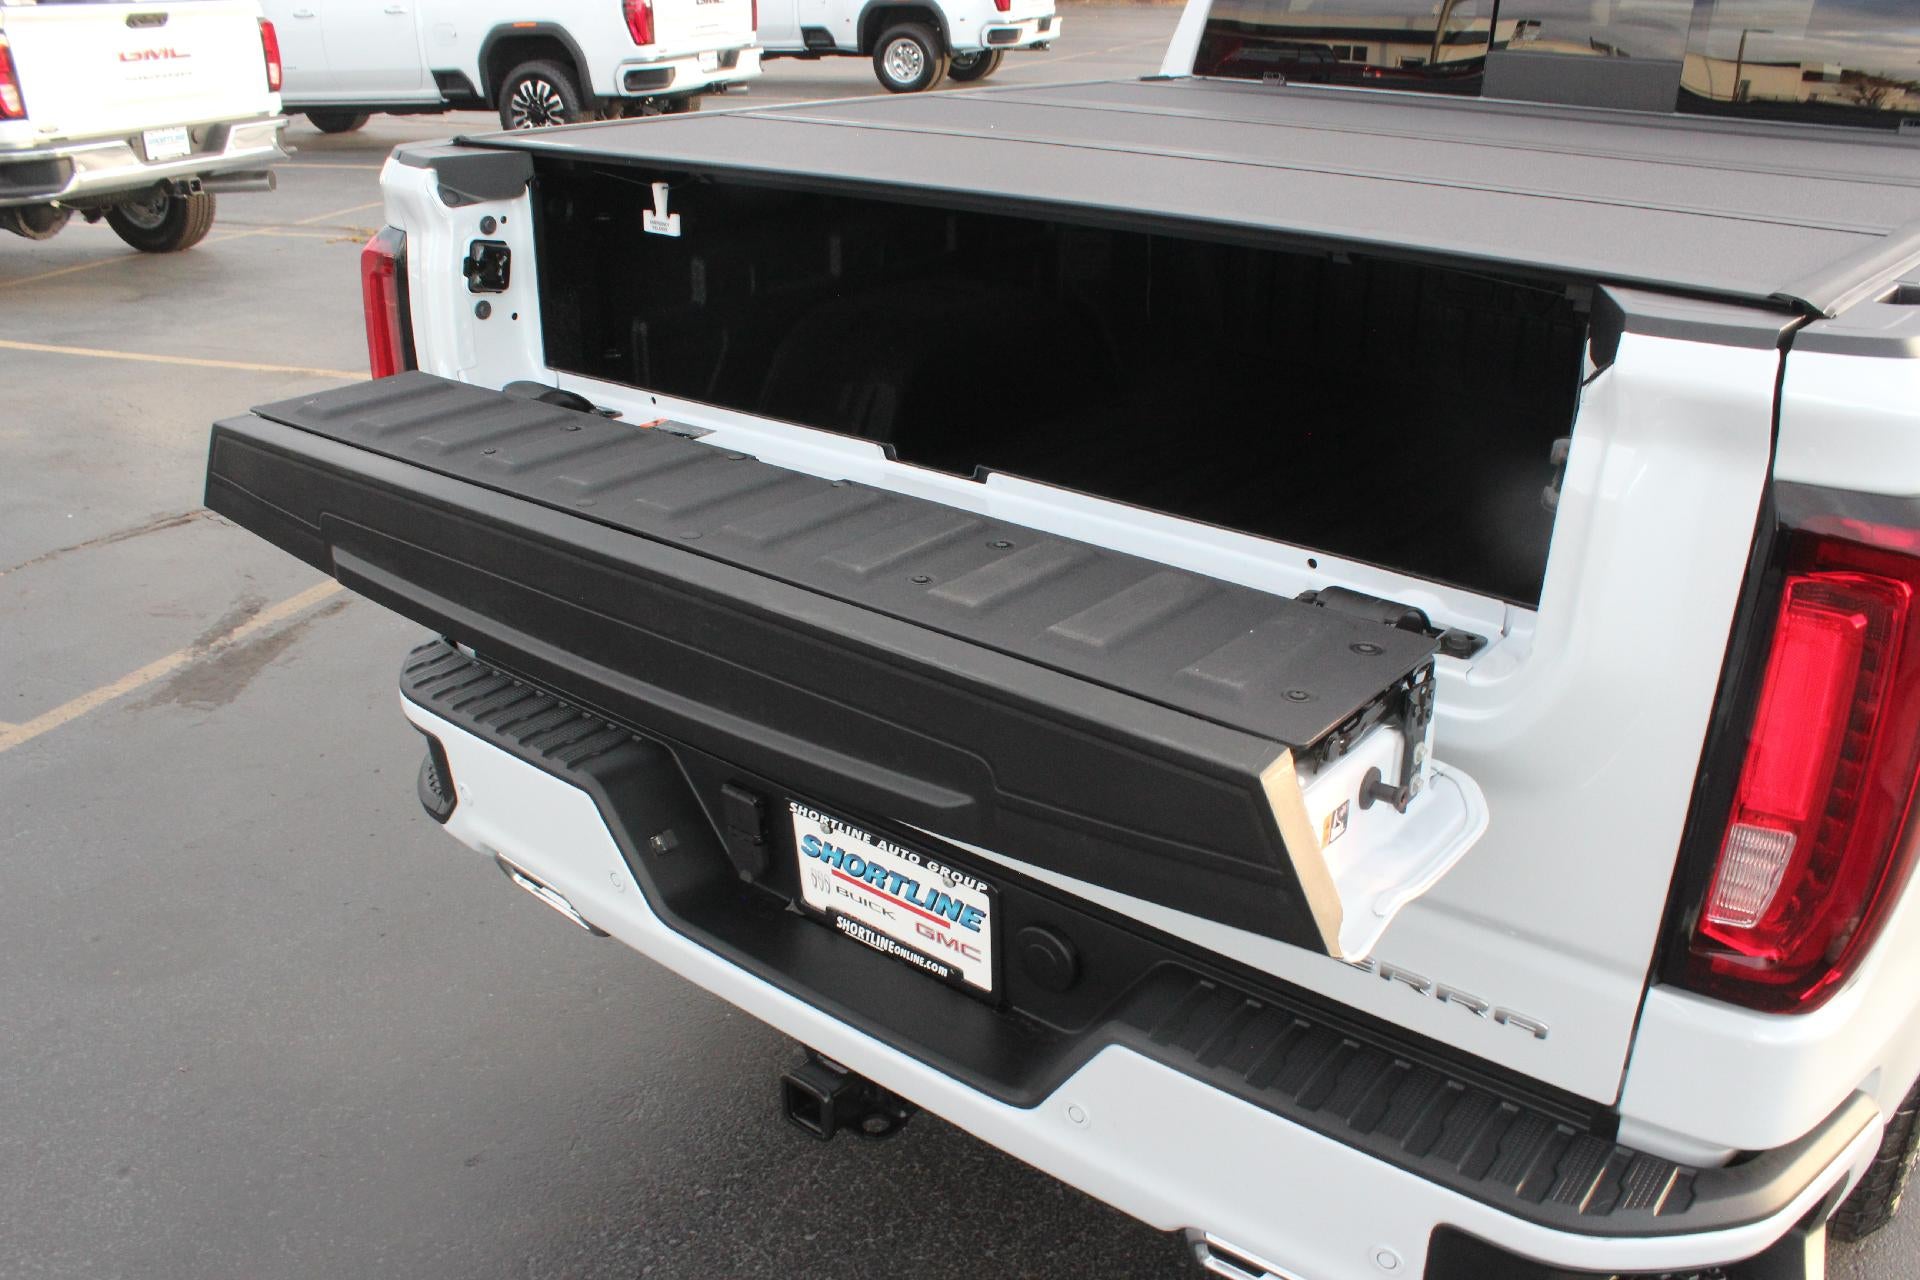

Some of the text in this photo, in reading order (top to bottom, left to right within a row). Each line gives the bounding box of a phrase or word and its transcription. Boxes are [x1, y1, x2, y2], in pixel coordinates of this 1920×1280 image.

[789, 802, 988, 892] SHORTLINE AUTO GROUP
[800, 833, 987, 933] SHORTLINE
[835, 885, 896, 920] BUICK
[915, 921, 982, 963] GMC
